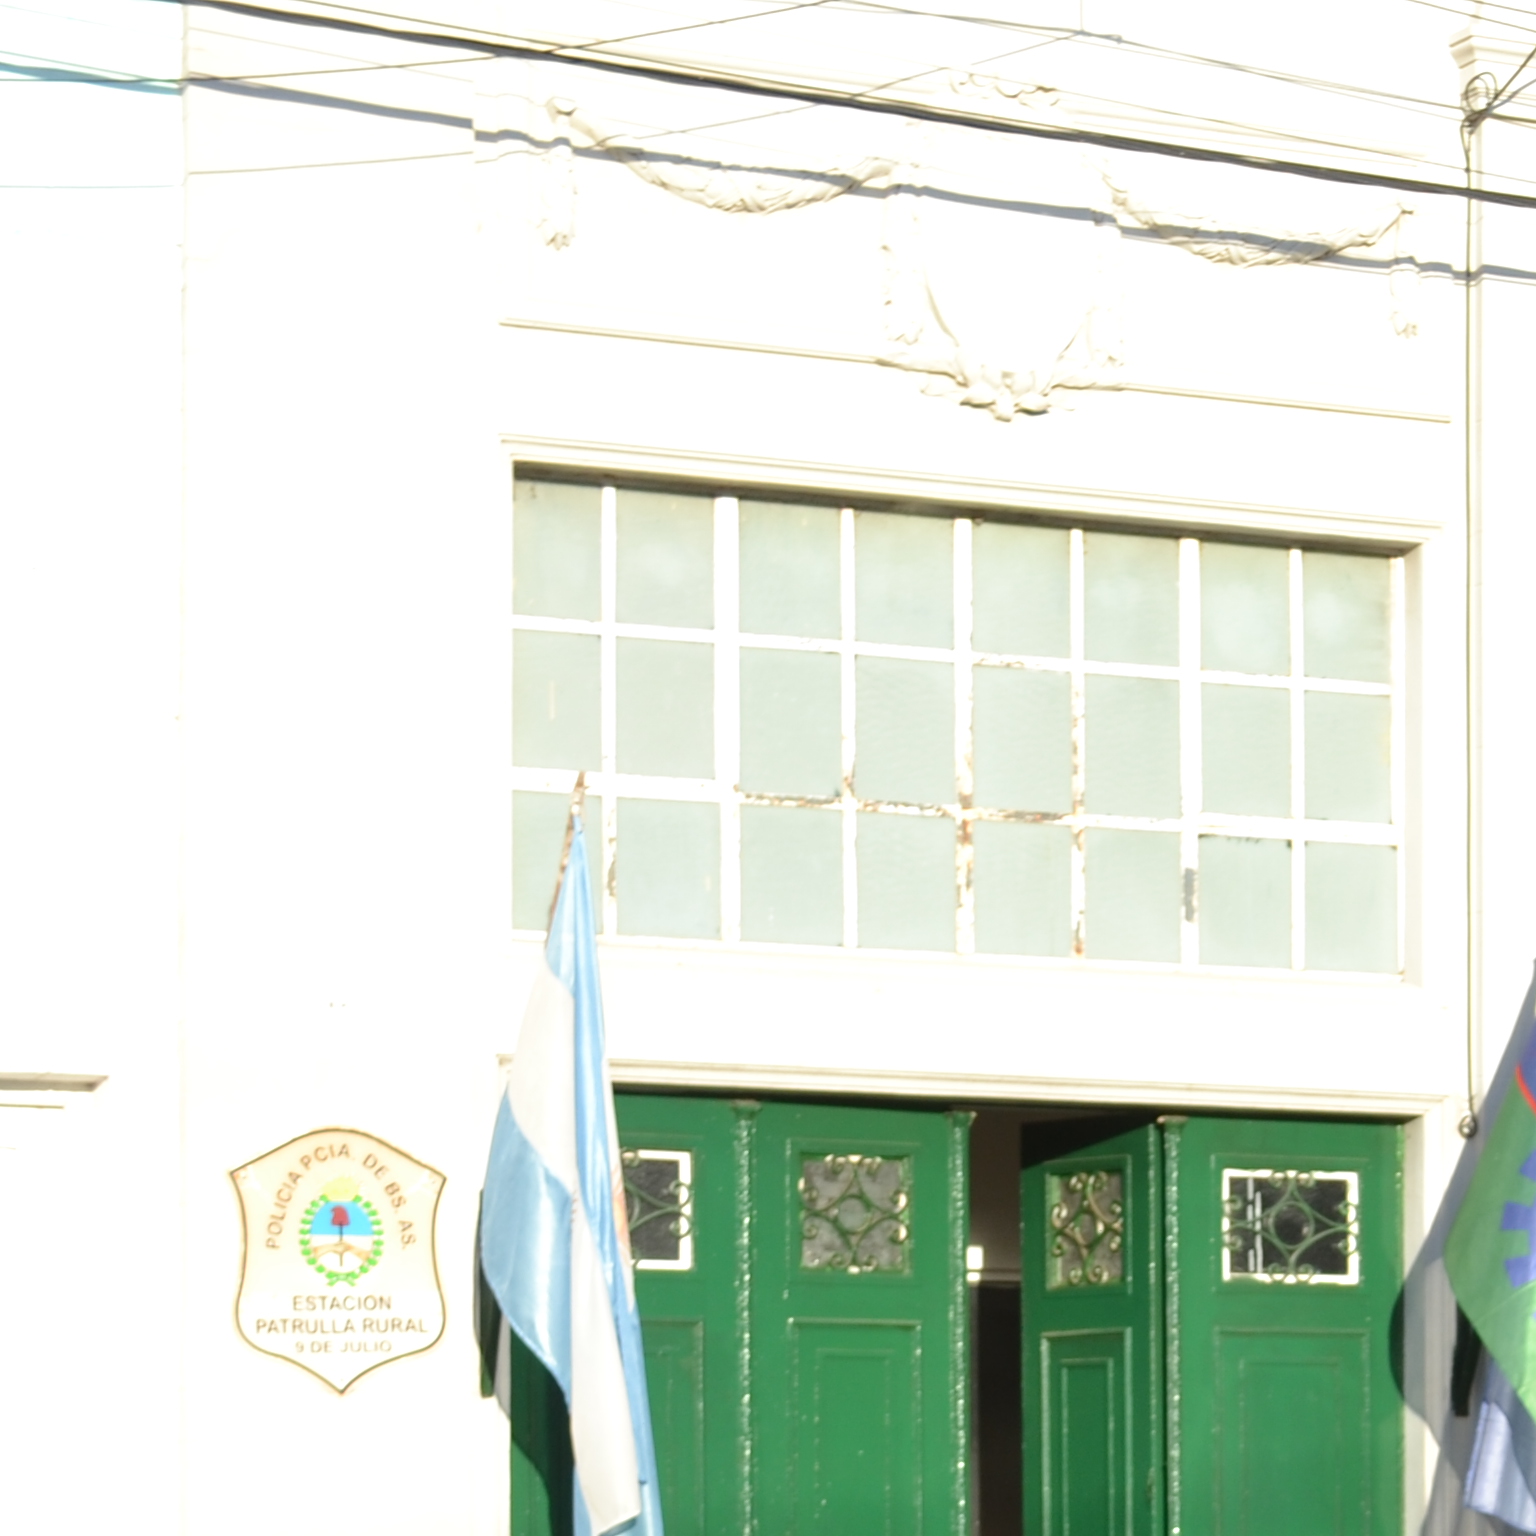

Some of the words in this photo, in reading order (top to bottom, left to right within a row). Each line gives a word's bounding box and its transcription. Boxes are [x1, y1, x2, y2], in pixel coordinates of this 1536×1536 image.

[265, 1171, 303, 1249] POLICIA
[362, 1153, 388, 1178] DE
[256, 1318, 356, 1334] PATRULLA
[363, 1317, 428, 1333] RURAL
[296, 1340, 303, 1353] 9
[311, 1340, 332, 1353] DE
[340, 1340, 392, 1353] JULIO
